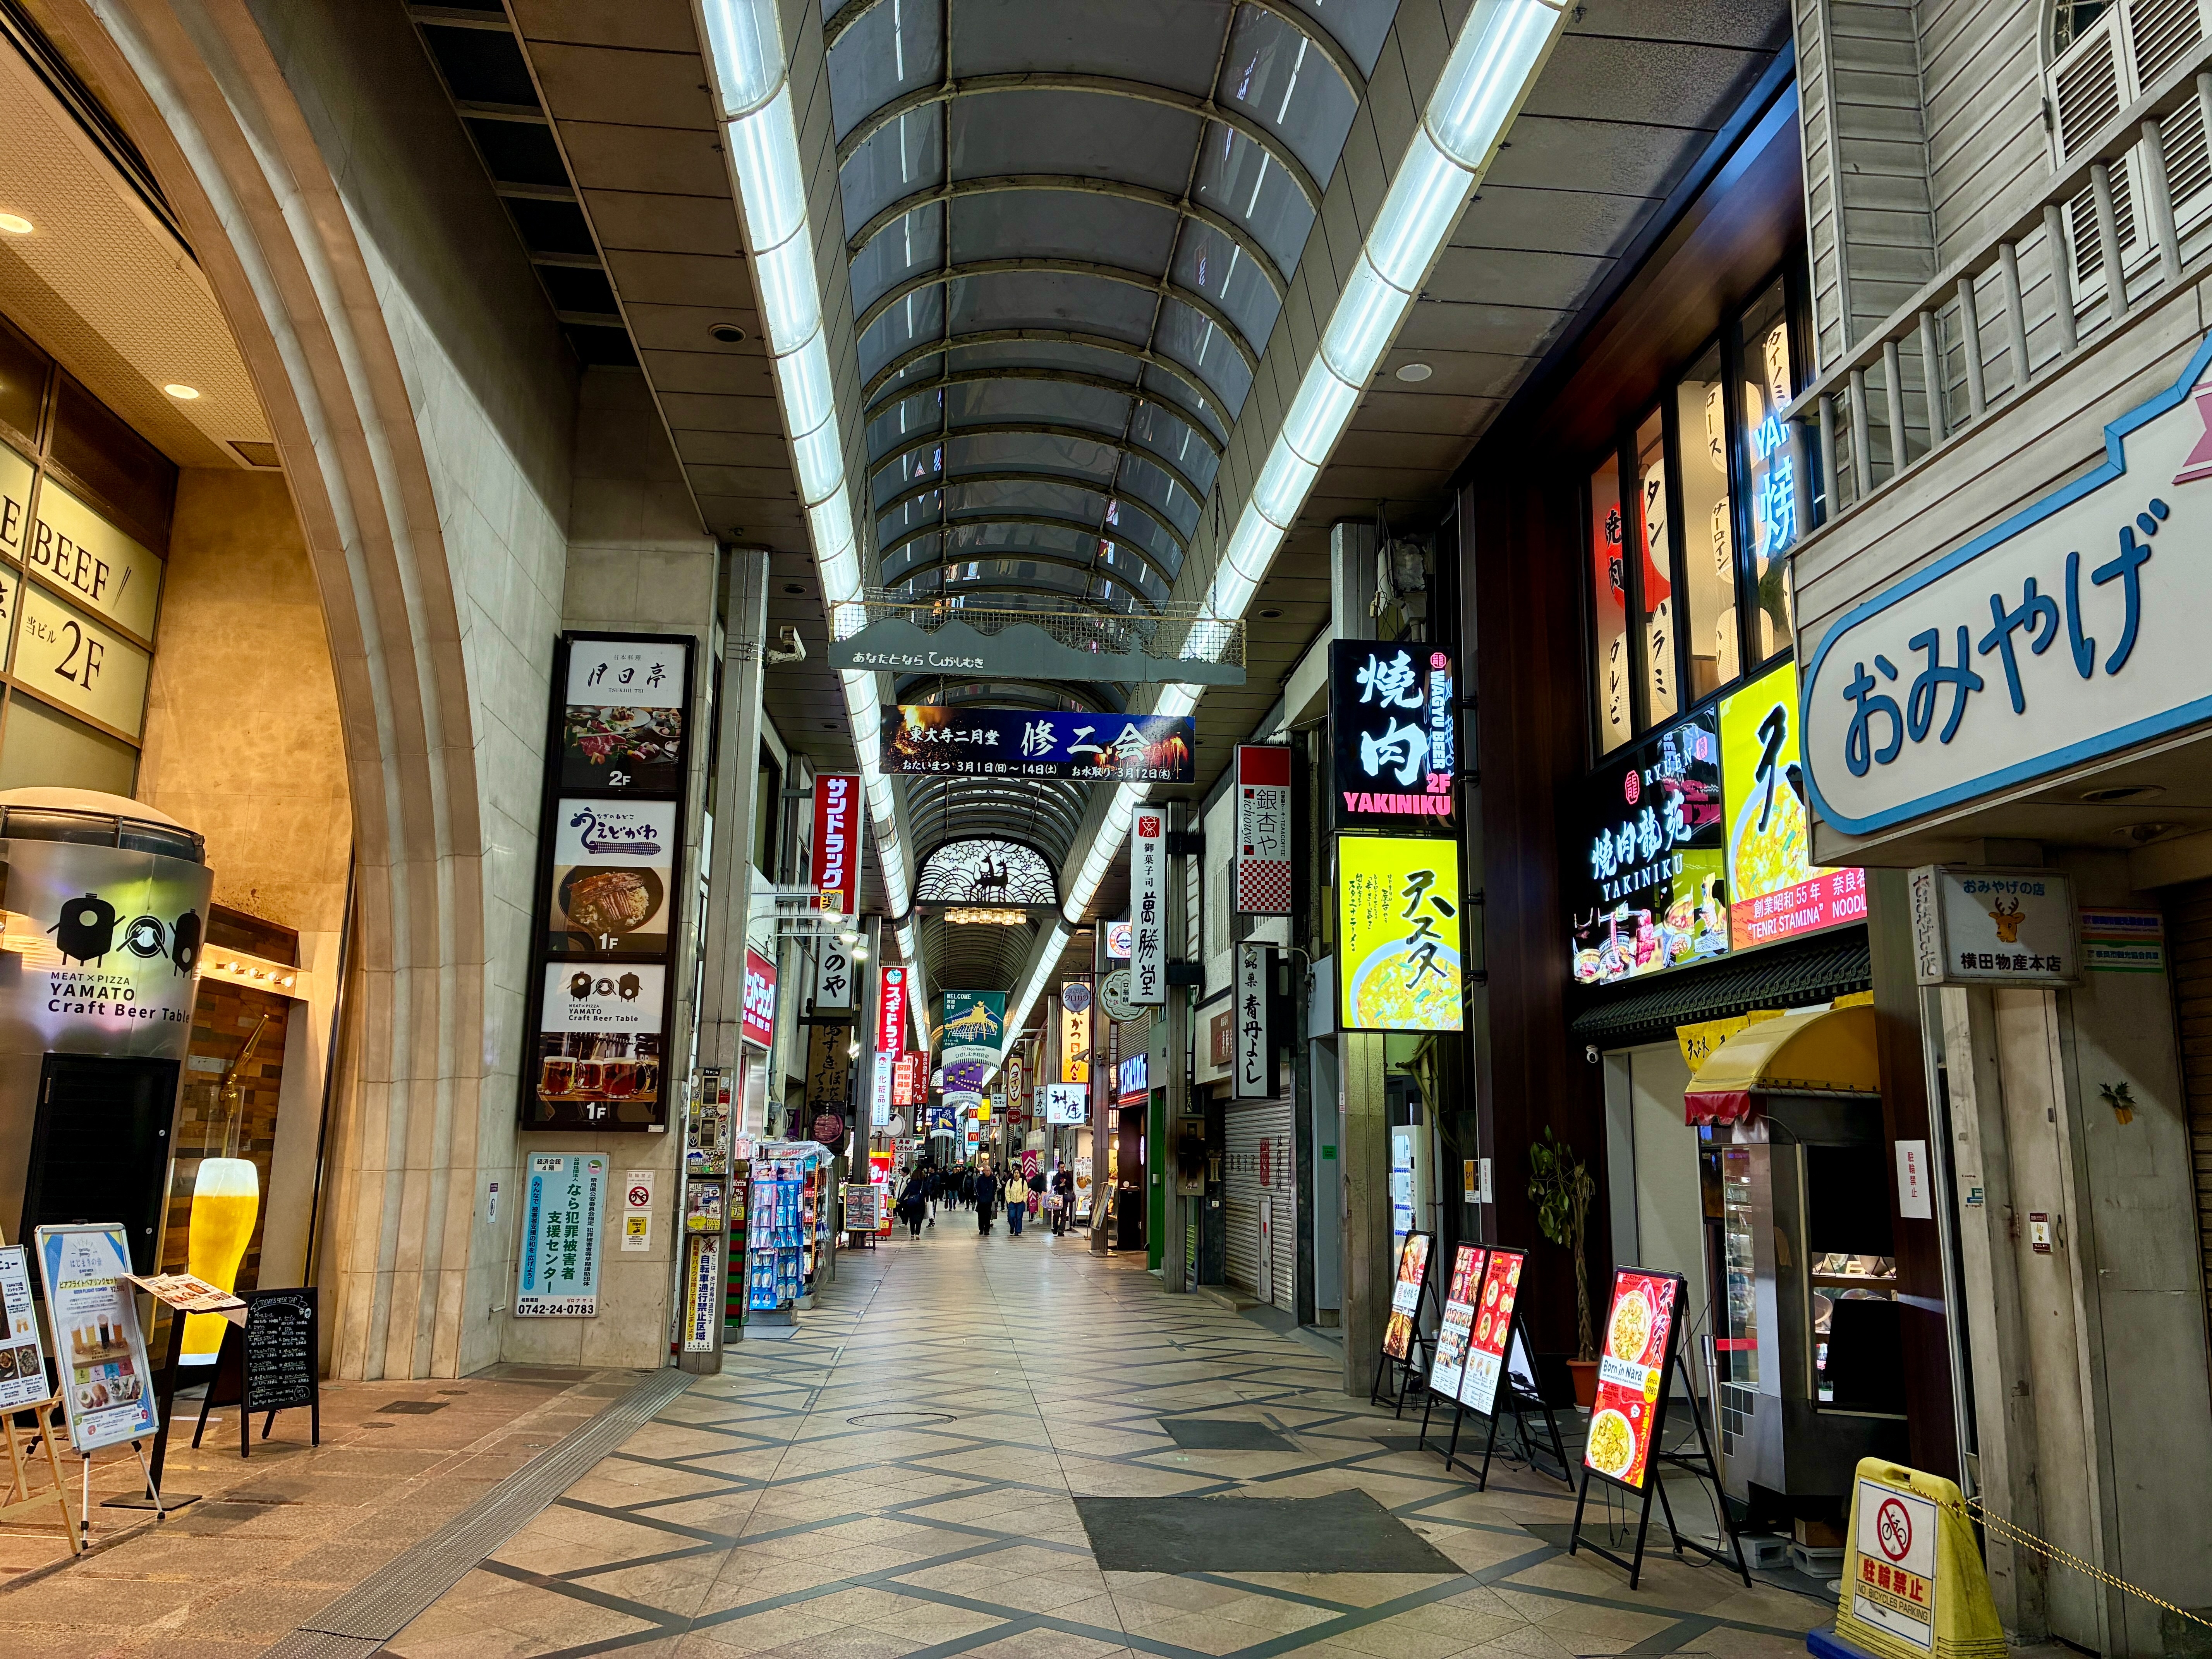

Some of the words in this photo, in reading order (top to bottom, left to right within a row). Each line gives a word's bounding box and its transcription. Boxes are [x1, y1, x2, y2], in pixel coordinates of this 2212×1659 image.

[1646, 480, 1664, 547] タン
[1713, 503, 1729, 571] サーロイン
[31, 518, 109, 601] BEEF
[25, 617, 56, 644] 当ビル
[54, 620, 104, 691] 2F
[1652, 602, 1668, 695] ハラミ
[1843, 498, 2169, 777] おみやげ
[853, 653, 924, 666] あなたとなら
[928, 651, 984, 669] ひがしむき
[1431, 670, 1445, 727] WAGYU
[1610, 638, 1620, 725] カルビ
[908, 725, 1000, 745] 東大寺二月堂
[1020, 719, 1151, 761] 修二会
[609, 771, 631, 786] 2F
[903, 760, 950, 771] おたいまつ
[1072, 766, 1110, 778] お水取り
[1426, 773, 1451, 793] 2F
[1645, 747, 1692, 786] RYUEN
[1242, 799, 1255, 844] ichouya
[1256, 788, 1278, 856] 銀杏や
[1343, 792, 1451, 815] YAKINIKU
[823, 779, 847, 888] サンドラッグ
[1144, 843, 1154, 887] 御菓子司
[1603, 853, 1683, 902] YAKINIKU
[1963, 879, 2045, 896] おみやげの店
[599, 933, 619, 950] 1F
[1139, 891, 1159, 996] 萬勝堂
[1960, 952, 2061, 972] 横田物産本店
[50, 983, 135, 1001] YAMATO
[48, 999, 105, 1015] Craft
[114, 1003, 156, 1020] Beer
[161, 1008, 190, 1024] Table
[885, 987, 901, 1060] スギドラッグ
[1070, 1012, 1084, 1039] かつ
[1243, 994, 1262, 1084] 青丹よし
[878, 1075, 886, 1103] 化粧品
[1011, 1071, 1019, 1098] ダイソー
[1036, 1088, 1044, 1115] 牛カツ
[586, 1102, 606, 1119] 1F
[532, 1181, 541, 1205] みんなで
[561, 1183, 582, 1280] なら犯罪被害者
[543, 1211, 562, 1293] 支援センター
[518, 1304, 594, 1314] 0742-24-0783
[696, 1255, 710, 1341] 自転車通行禁止区域
[1603, 1359, 1618, 1374] Born
[1618, 1363, 1625, 1376] in
[1625, 1366, 1643, 1382] Nara.
[1647, 1377, 1658, 1385] since
[1645, 1385, 1657, 1396] 1980
[1863, 1558, 1923, 1602] 駐輪禁止
[1858, 1585, 1866, 1595] NO
[1869, 1588, 1898, 1608] BICYCLES
[1899, 1602, 1928, 1621] PARKING
